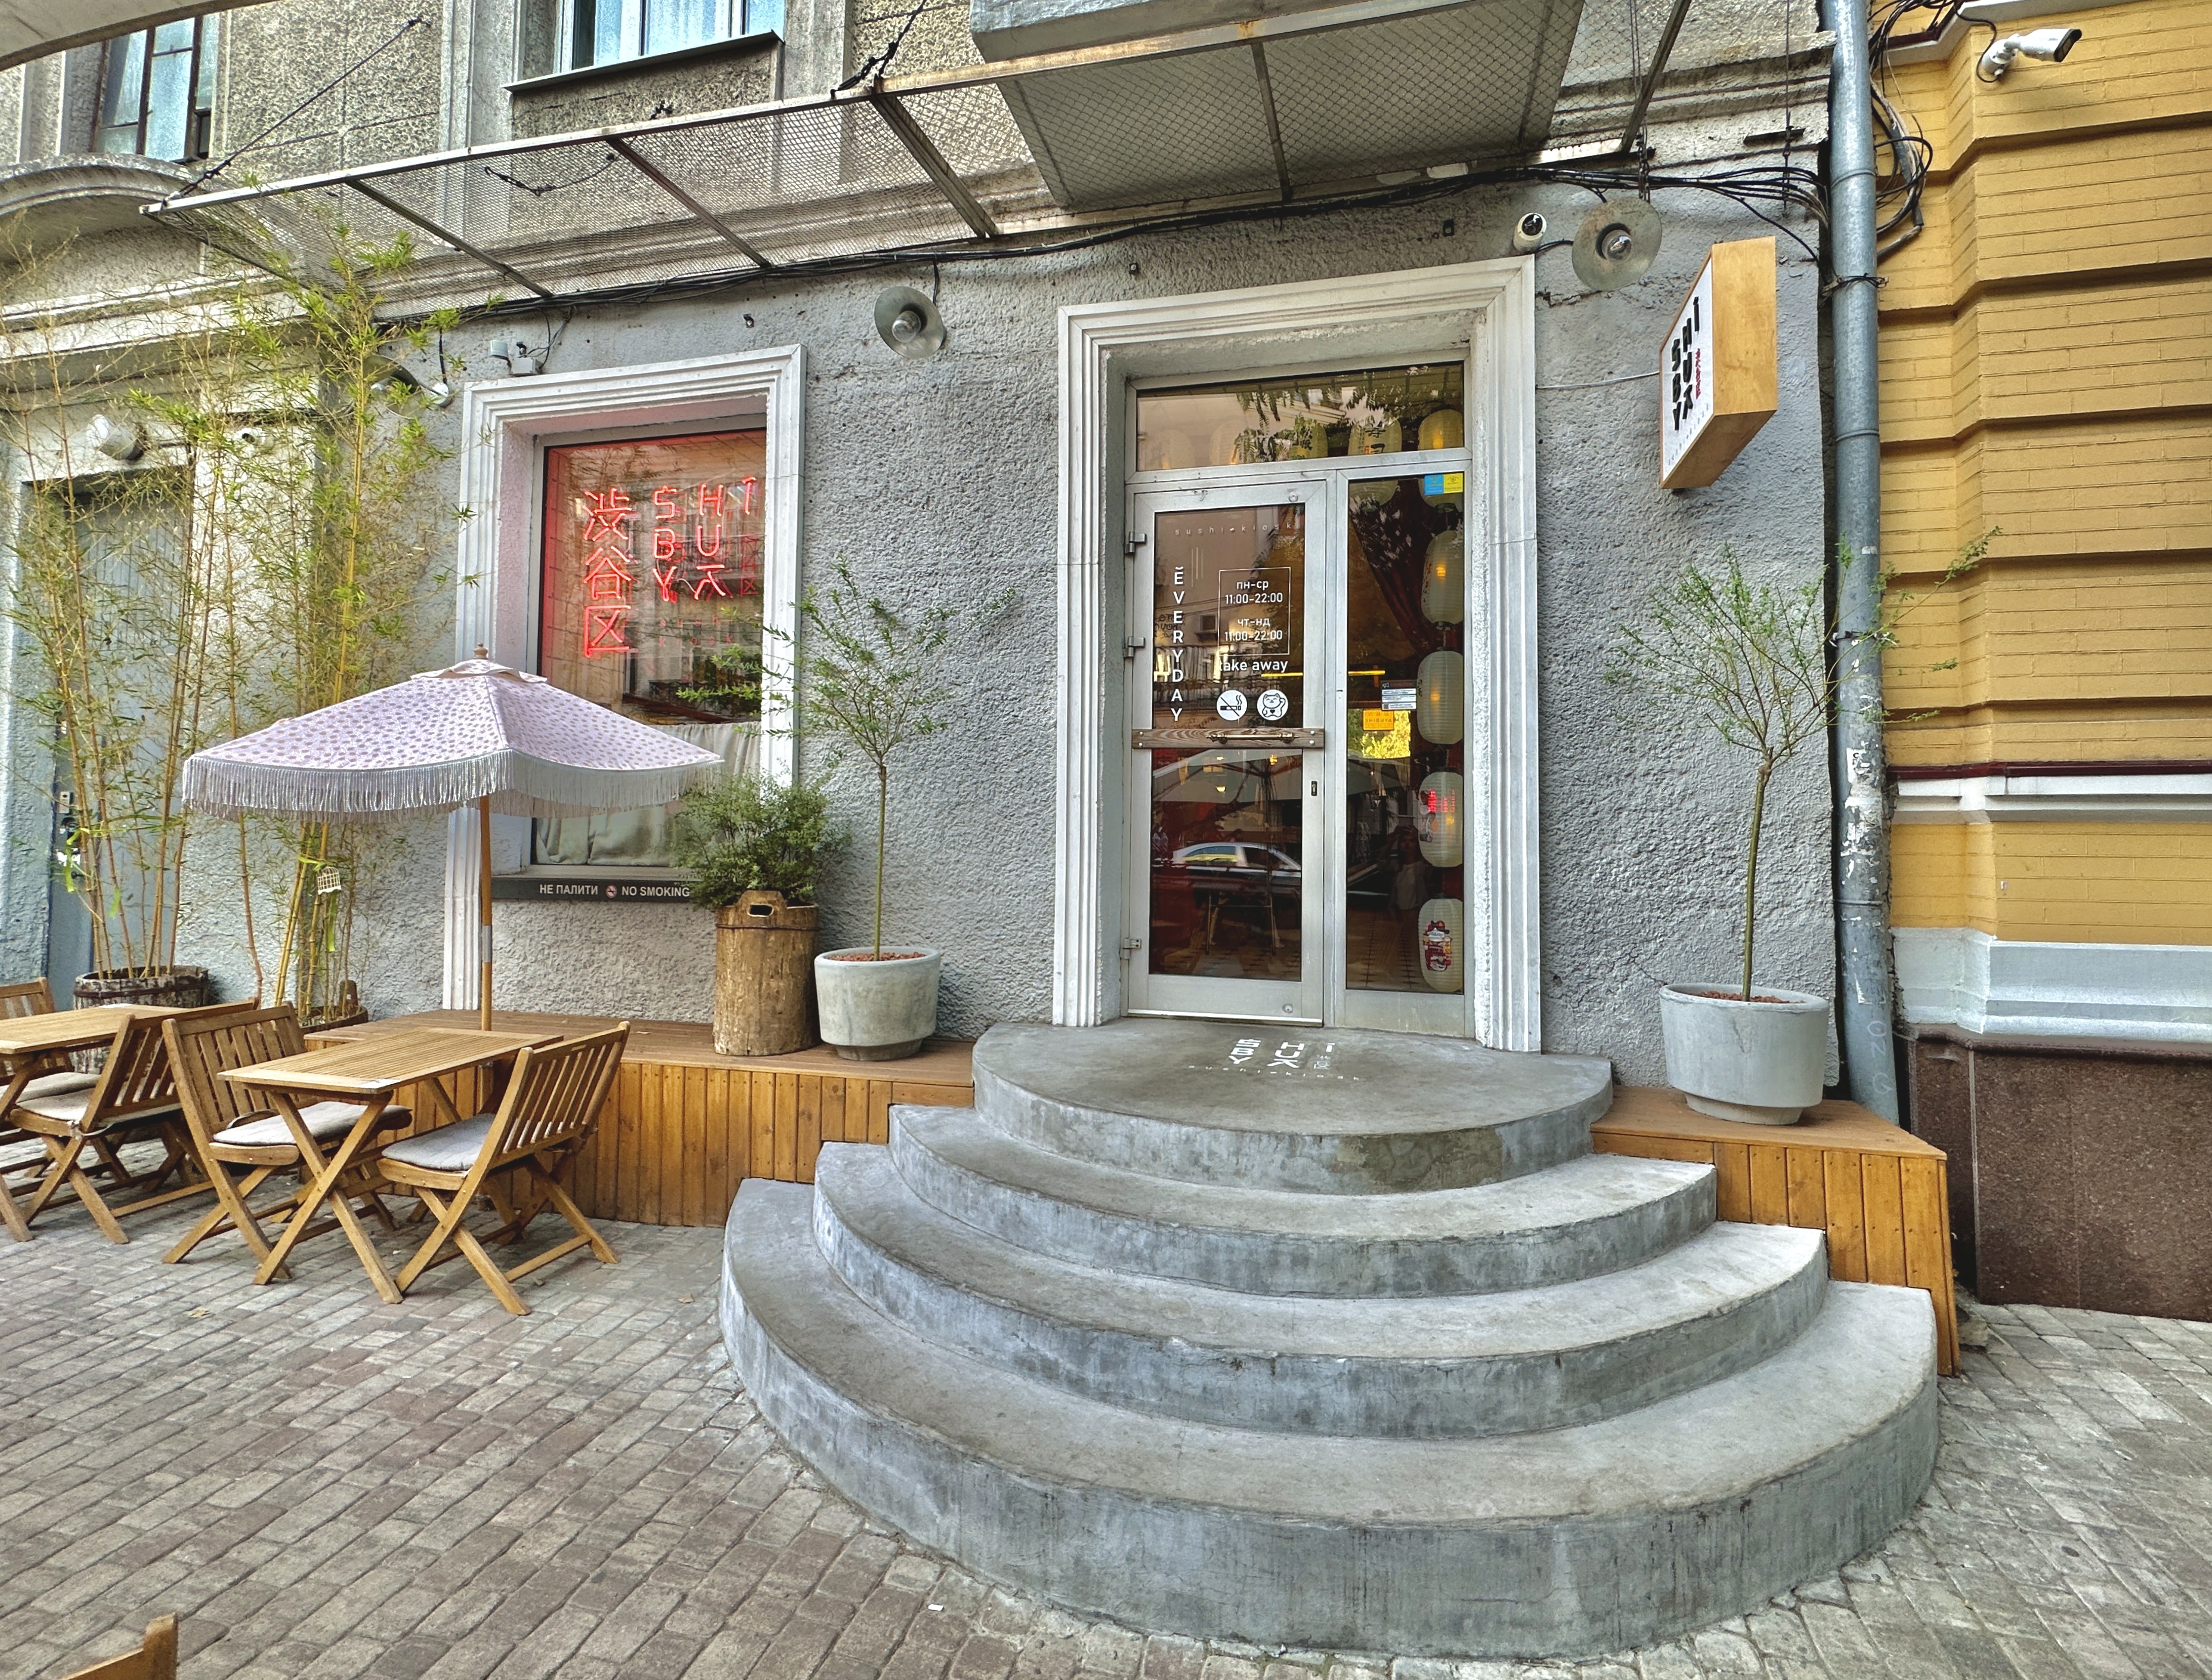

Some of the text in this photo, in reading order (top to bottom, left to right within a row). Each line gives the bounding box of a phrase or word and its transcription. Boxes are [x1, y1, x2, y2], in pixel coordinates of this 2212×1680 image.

[652, 524, 721, 559] BU
[583, 488, 632, 658] 渋谷区
[1236, 581, 1269, 590] пн-ср
[1225, 592, 1283, 604] 11:00-22:00
[1237, 618, 1270, 627] чт-нд
[1252, 661, 1288, 673] away
[539, 884, 598, 895] НЕ ПАЛИТИ
[621, 886, 690, 897] NO SMOKING
